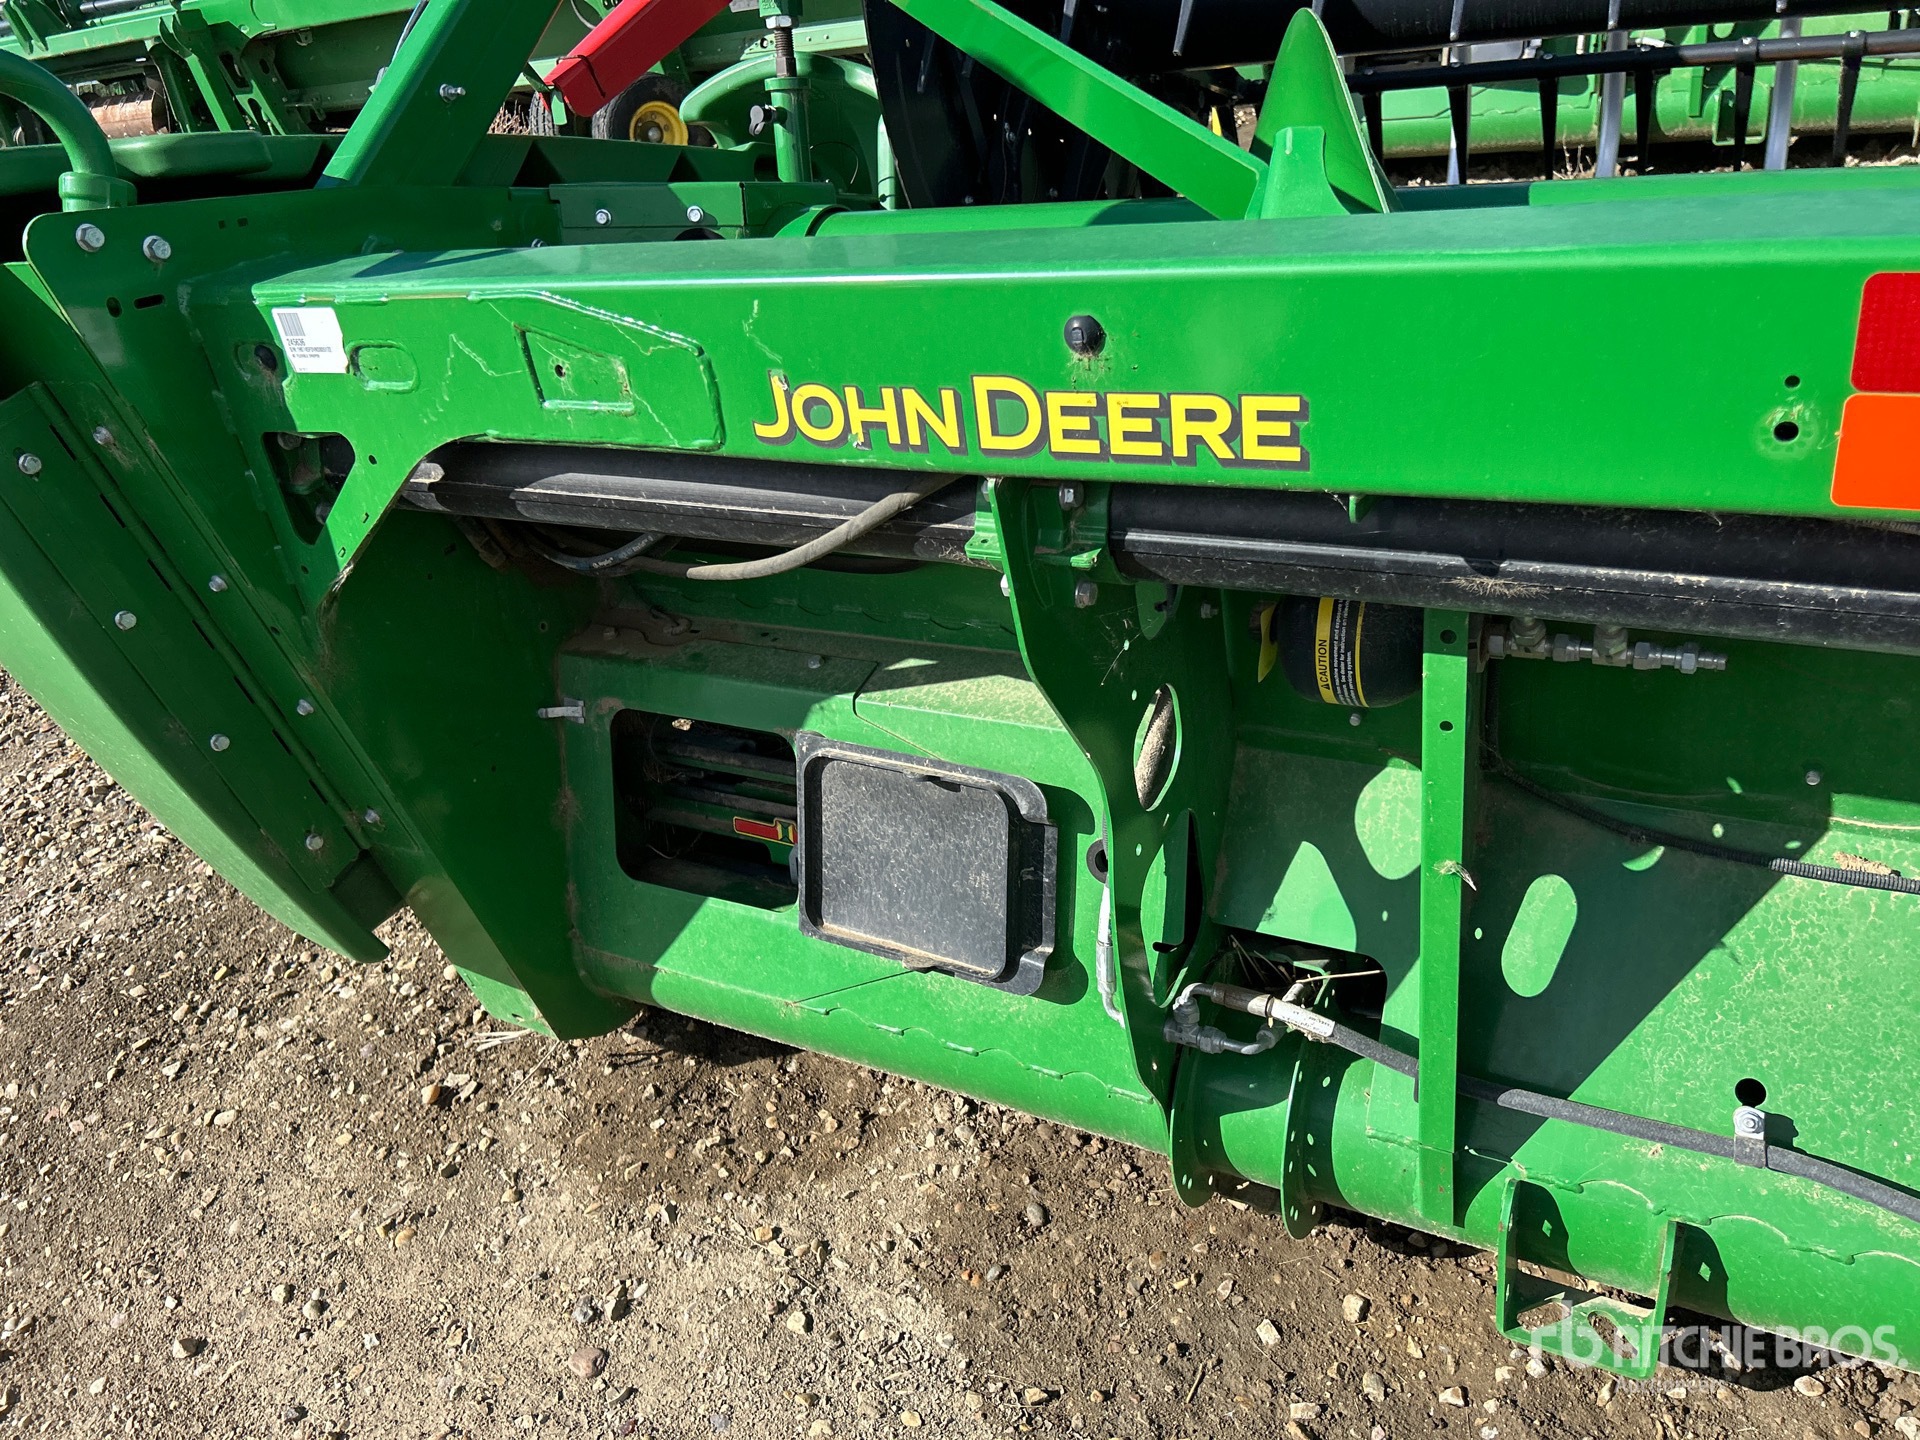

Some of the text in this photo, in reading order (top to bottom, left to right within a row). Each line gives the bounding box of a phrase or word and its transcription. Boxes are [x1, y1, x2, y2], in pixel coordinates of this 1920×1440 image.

[753, 369, 1310, 472] JOHN DEERE
[1335, 604, 1344, 629] exposure
[1318, 639, 1330, 682] CAUTION
